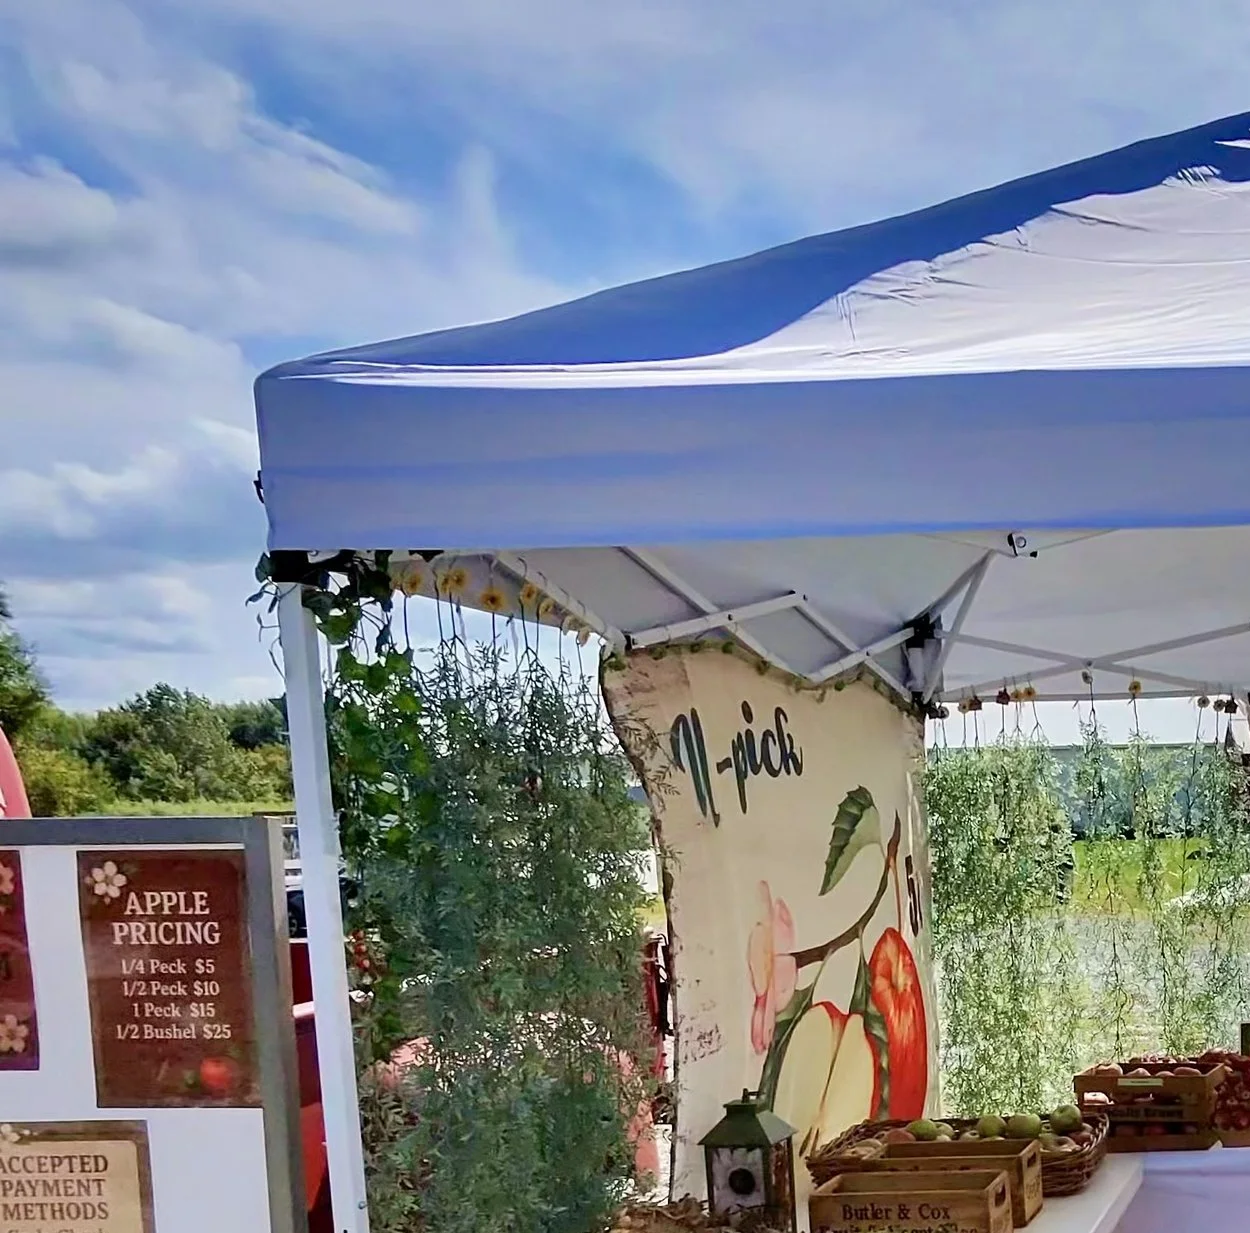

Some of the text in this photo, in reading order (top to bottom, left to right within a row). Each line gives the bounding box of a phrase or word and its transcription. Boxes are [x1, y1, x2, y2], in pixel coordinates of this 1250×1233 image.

[124, 891, 211, 915] APPLE
[112, 922, 222, 945] PRICING
[121, 958, 215, 974] 1/4 Peck $5
[122, 980, 220, 997] 1/2 Peck $10
[132, 1002, 216, 1018] 1 Peck $15
[116, 1024, 232, 1040] 1/2 Bushel $25
[1, 1179, 106, 1197] PAYMENT
[2, 1202, 109, 1221] METHODS
[842, 1203, 951, 1221] Butler & Cox
